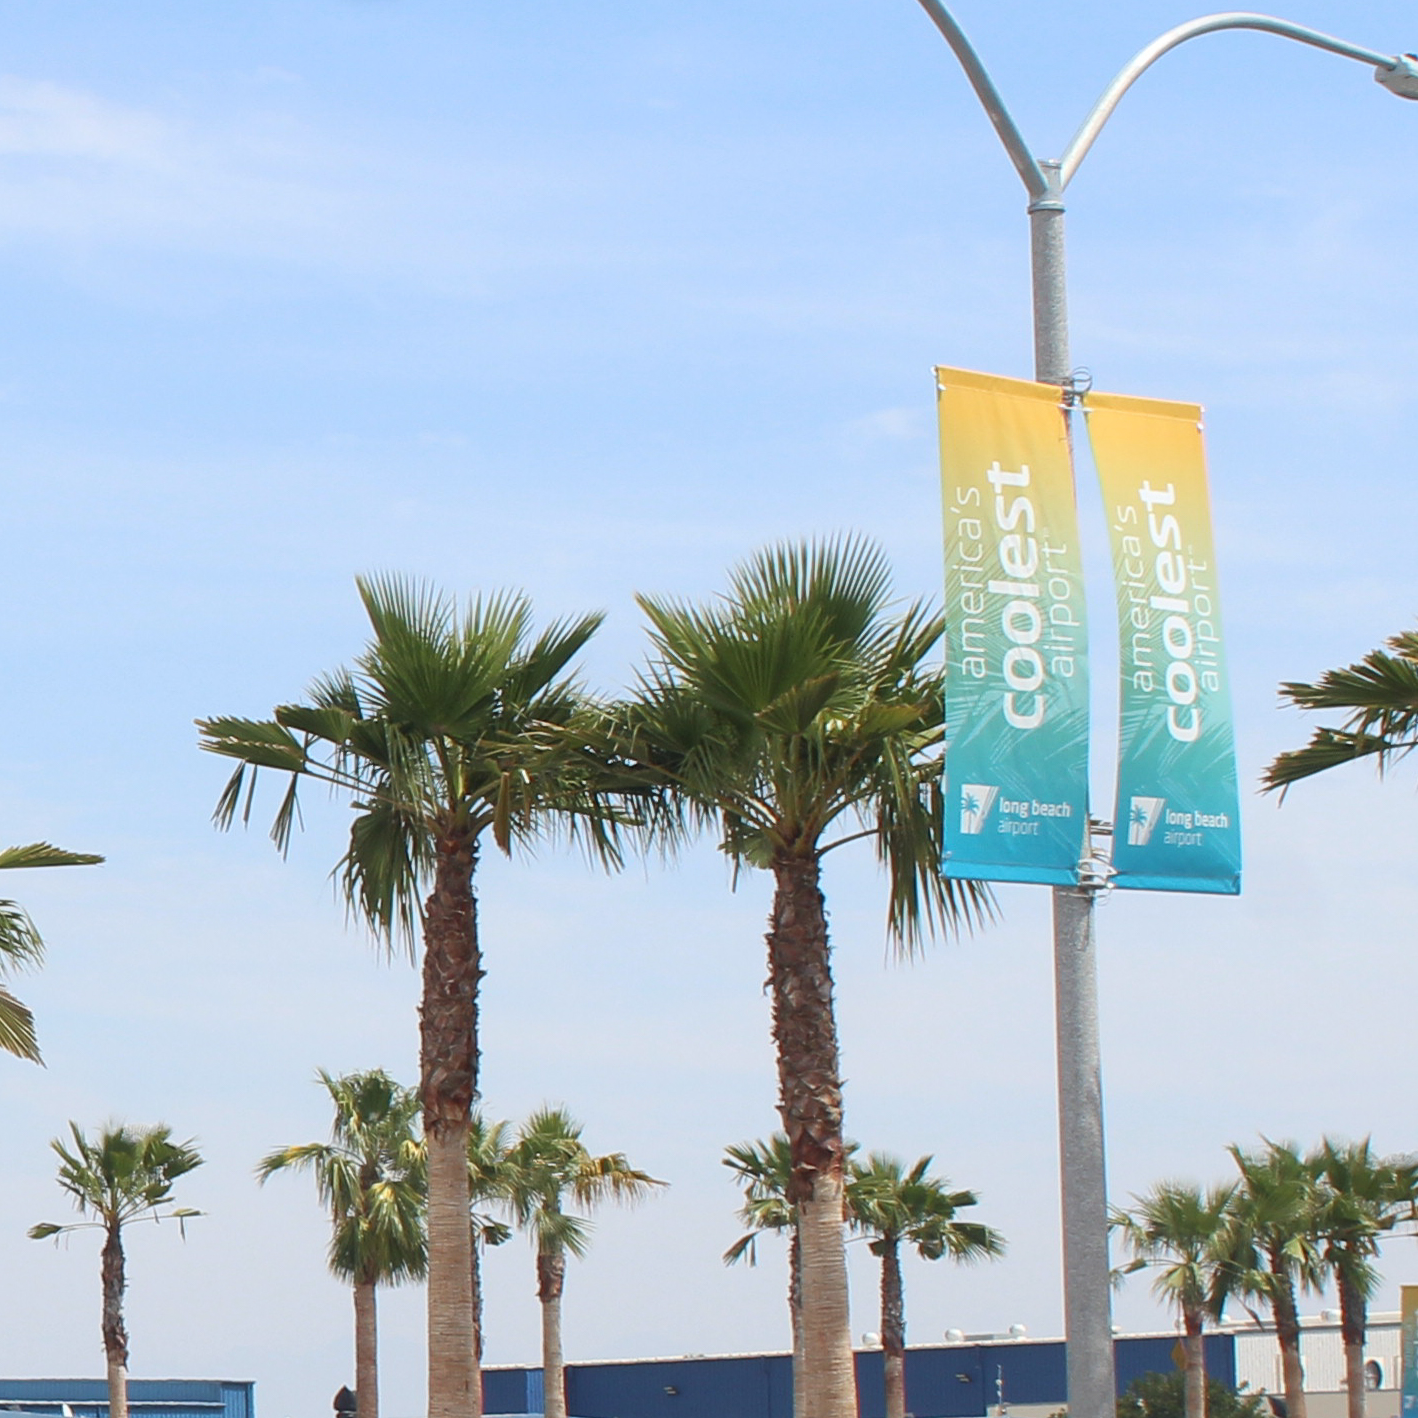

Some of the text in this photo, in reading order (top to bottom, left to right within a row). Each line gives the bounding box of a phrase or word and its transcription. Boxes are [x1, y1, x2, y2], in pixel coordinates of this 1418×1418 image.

[950, 486, 987, 680] america's
[987, 460, 1045, 730] coolest
[1042, 543, 1081, 679] airport
[1113, 503, 1155, 694] america's
[1138, 480, 1203, 744] coolest
[1186, 559, 1221, 693] airport
[996, 818, 1041, 838] airport
[998, 796, 1072, 819] long beach
[1163, 829, 1204, 849] airport
[1164, 807, 1230, 833] long beach
